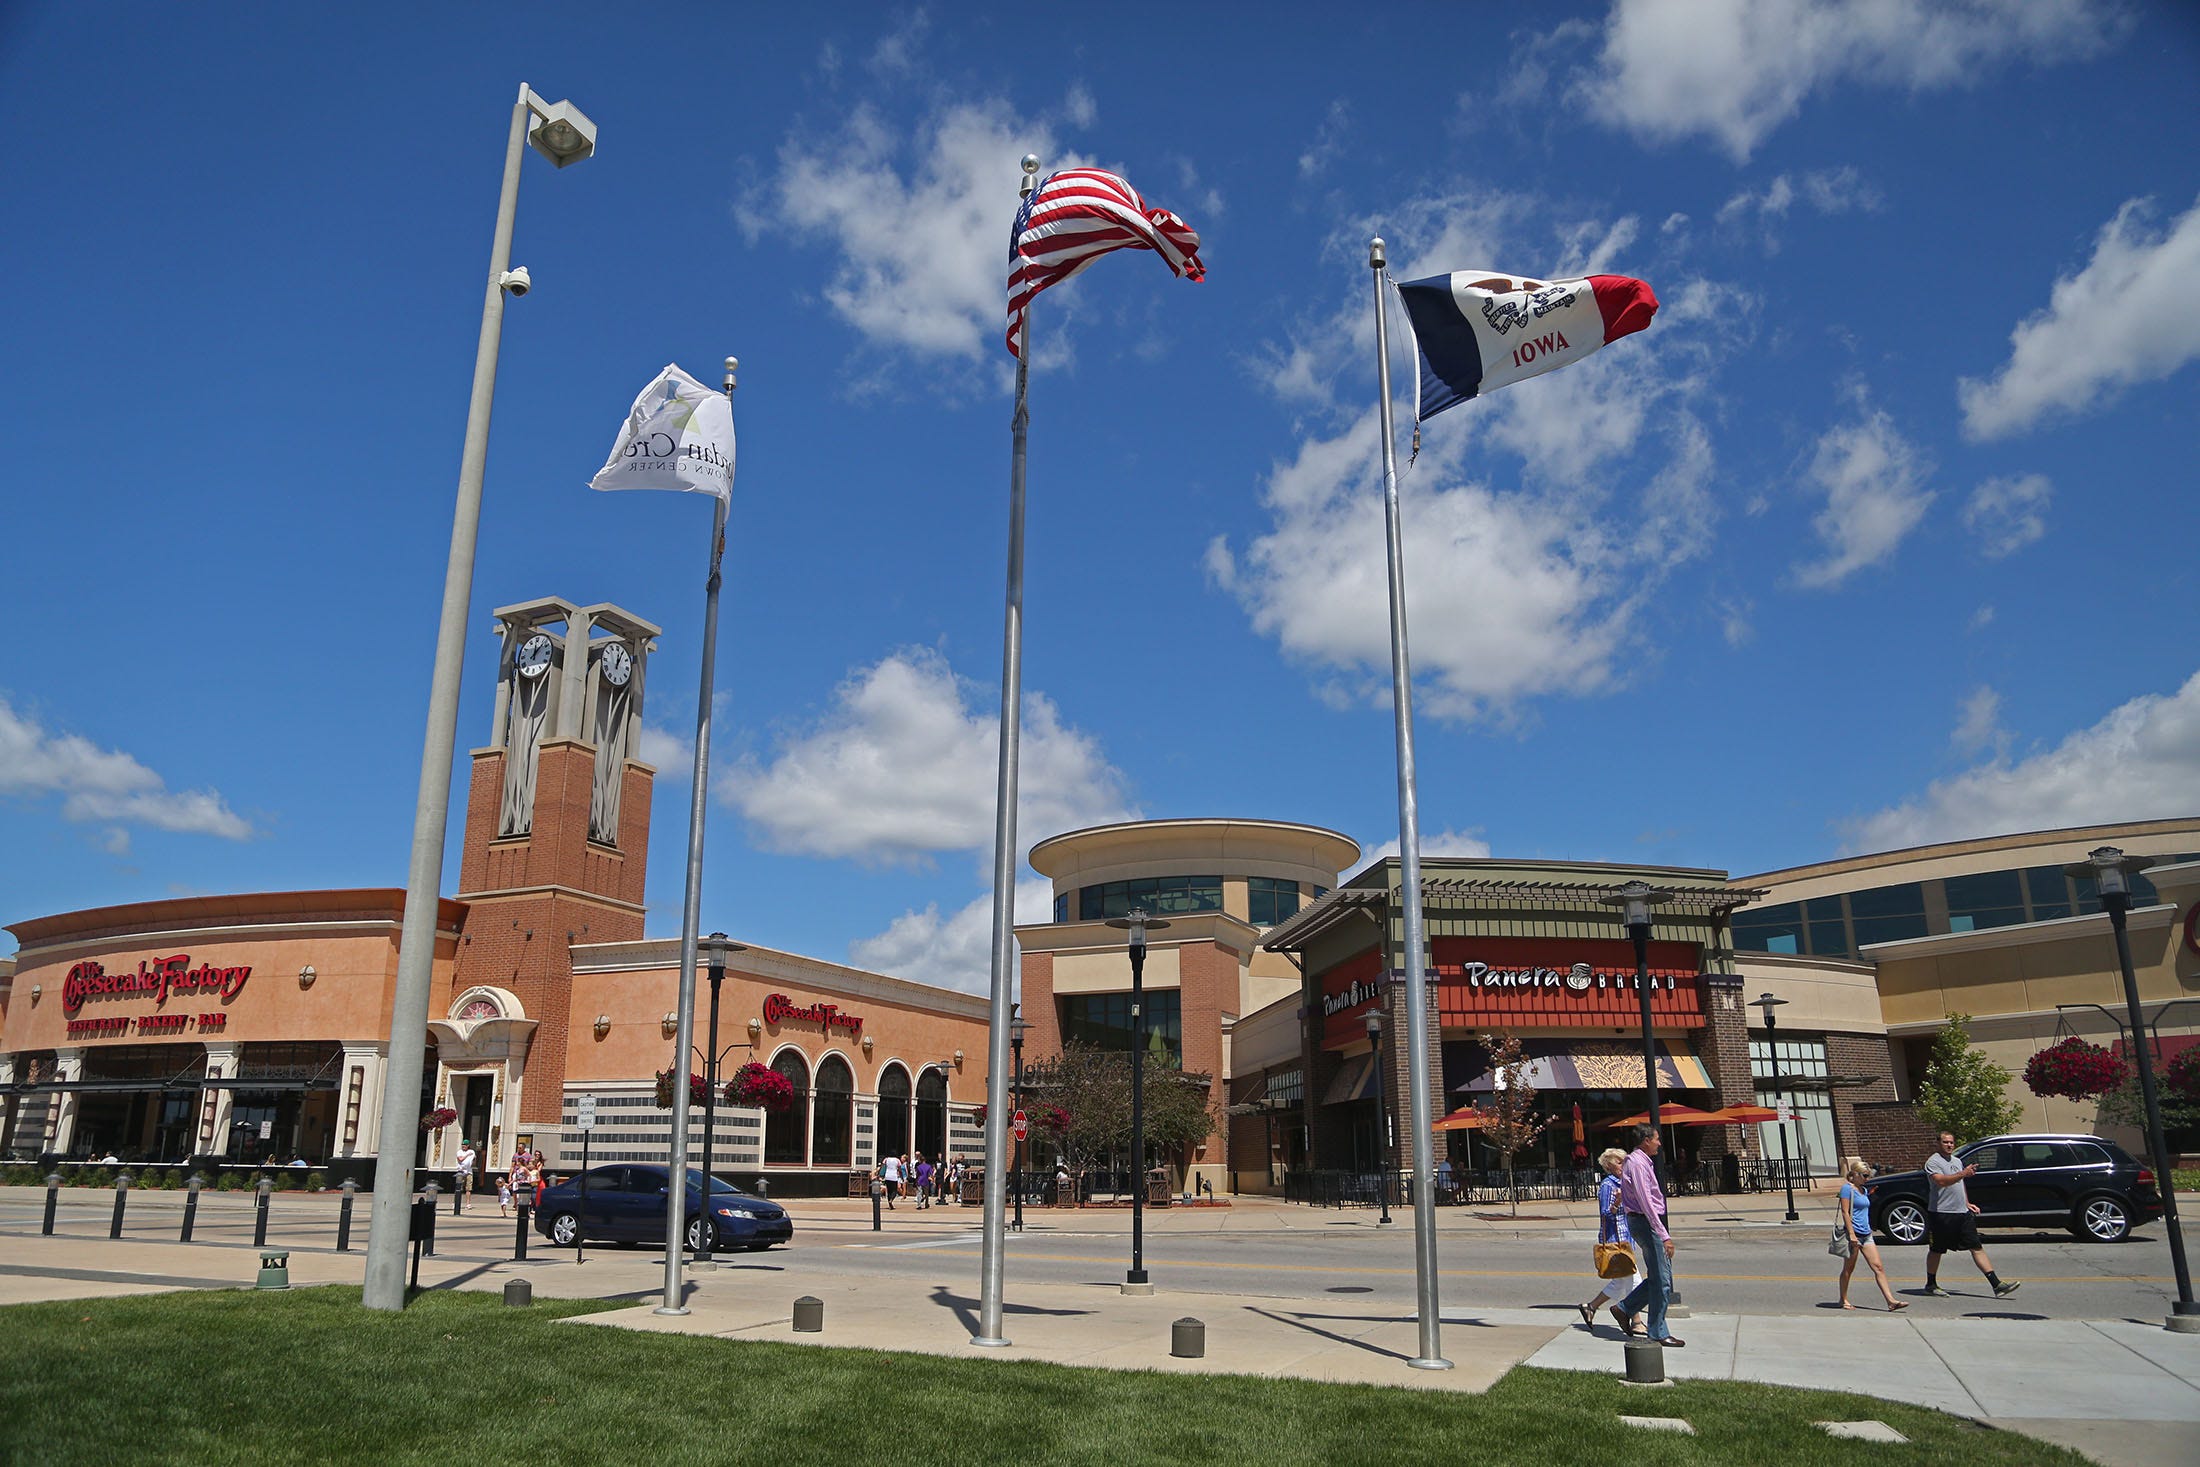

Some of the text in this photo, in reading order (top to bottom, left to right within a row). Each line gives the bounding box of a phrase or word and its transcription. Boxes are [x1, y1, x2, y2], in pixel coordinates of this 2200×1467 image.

[1511, 330, 1570, 367] IOWA
[83, 962, 104, 976] The
[1464, 962, 1561, 987] Panera
[63, 954, 252, 1011] Cheesecake Factory
[66, 1013, 227, 1032] RESTAURANT BAKERY BAR
[763, 993, 864, 1034] Cheesecake Factory
[1015, 1119, 1026, 1131] STOP
